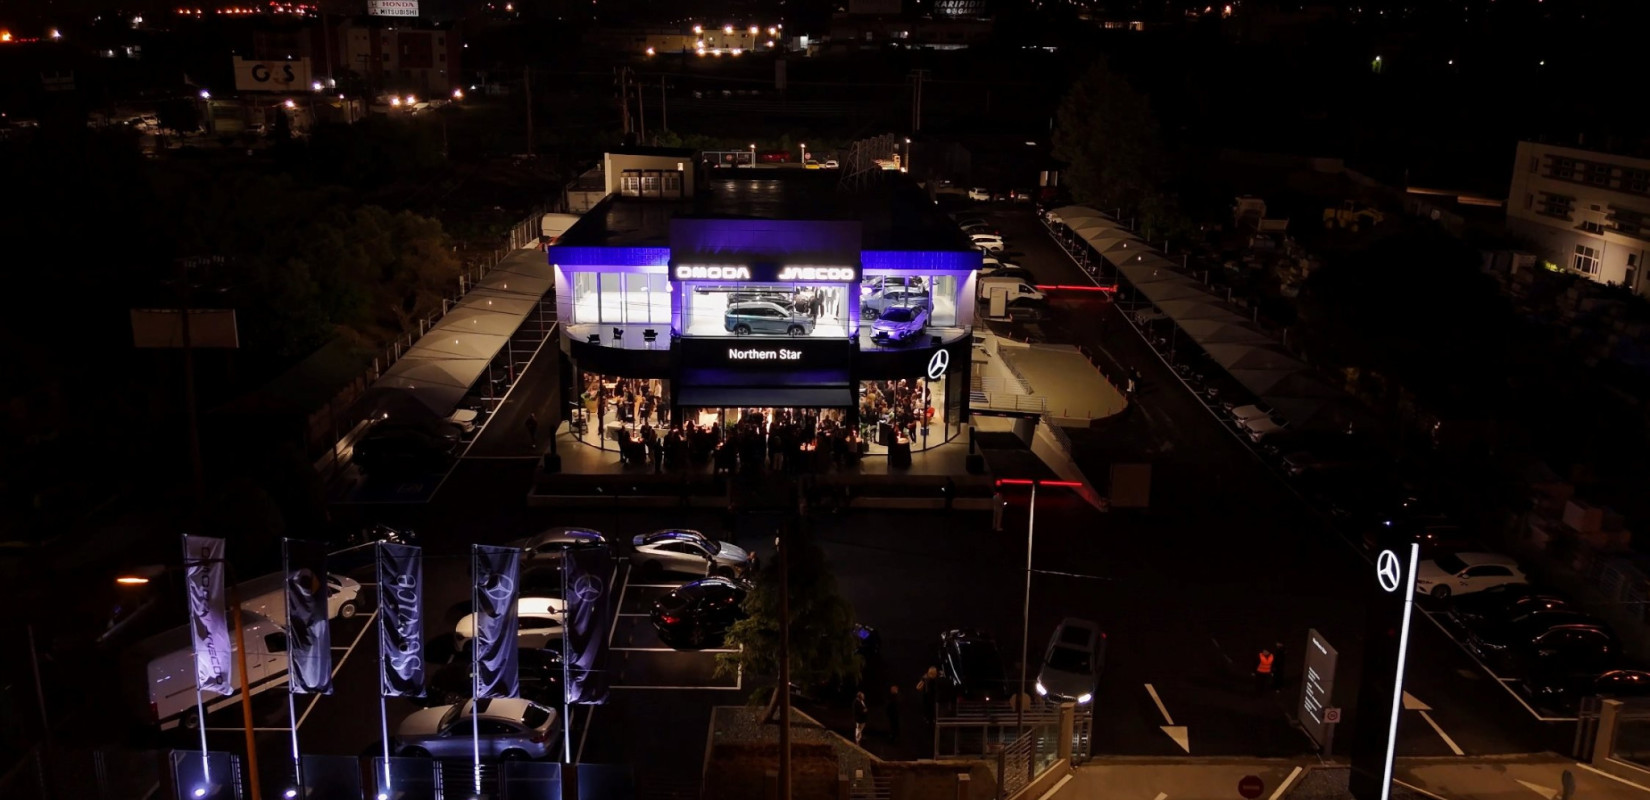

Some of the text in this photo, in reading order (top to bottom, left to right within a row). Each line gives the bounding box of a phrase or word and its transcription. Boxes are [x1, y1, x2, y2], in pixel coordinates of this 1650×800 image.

[677, 266, 750, 279] OMODA
[729, 348, 802, 360] Northern Star
[391, 574, 421, 671] Service
